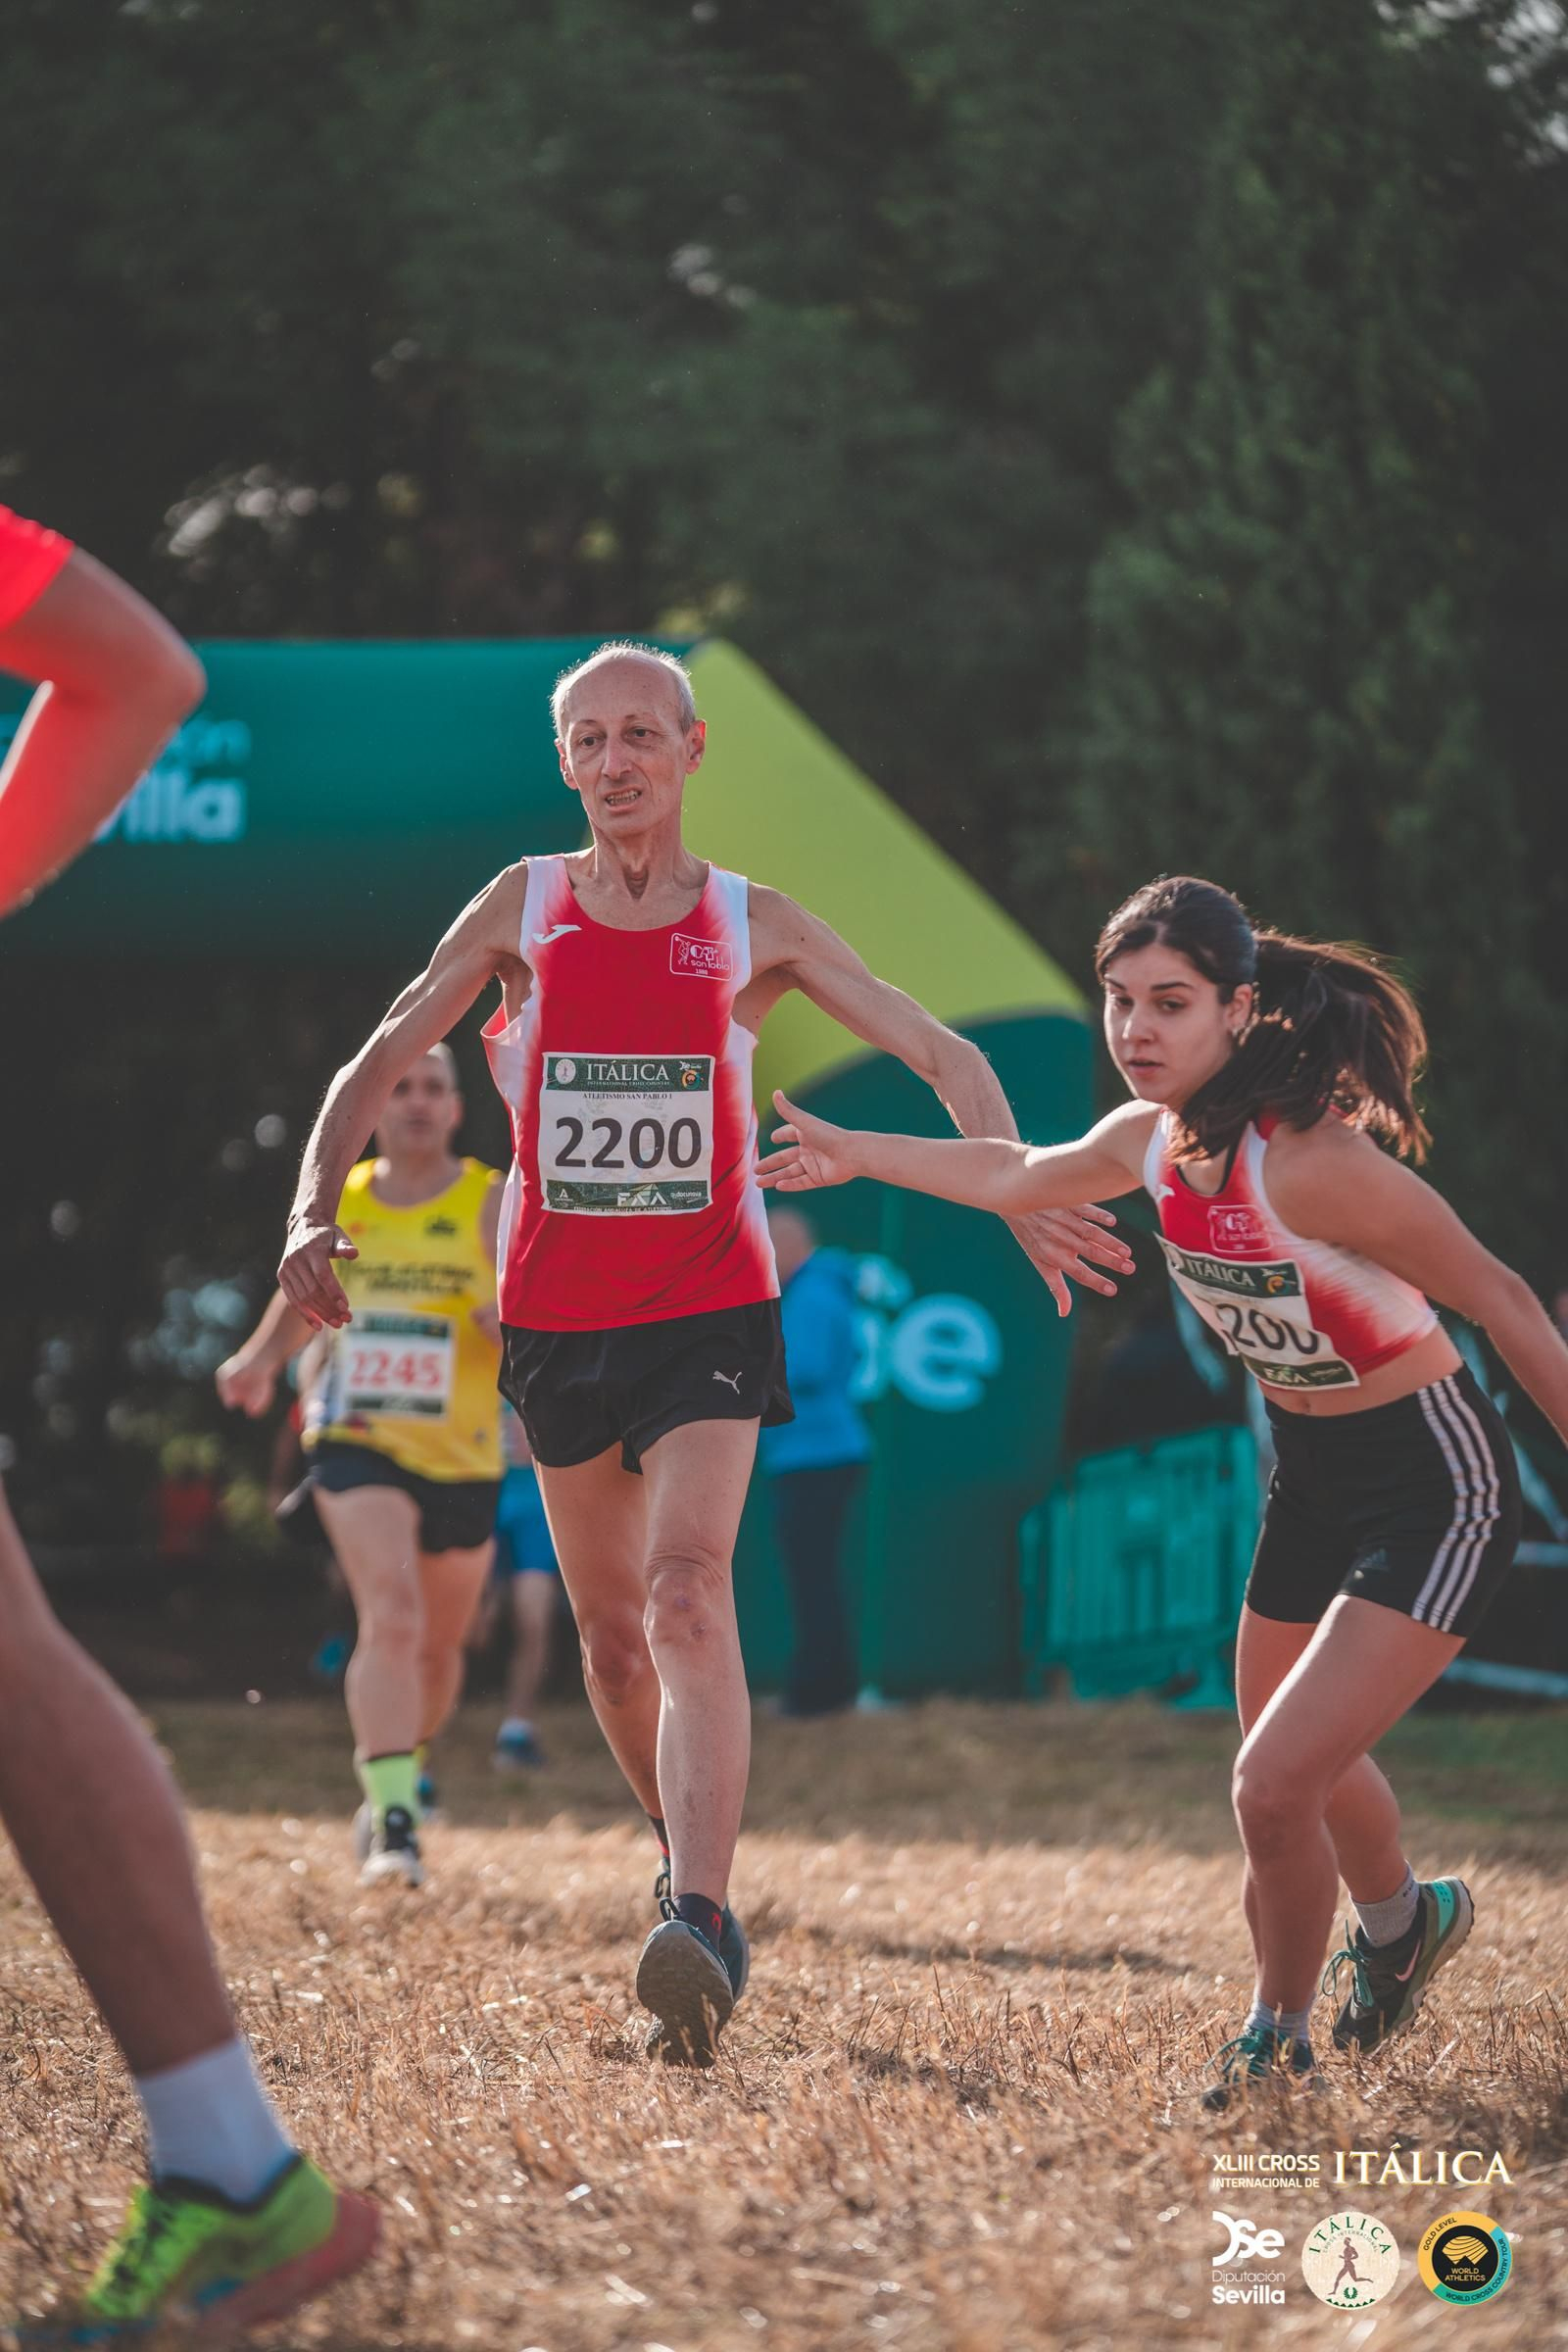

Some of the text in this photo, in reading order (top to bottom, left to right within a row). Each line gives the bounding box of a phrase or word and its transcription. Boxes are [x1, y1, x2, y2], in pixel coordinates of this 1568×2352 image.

[587, 1059, 670, 1082] ITÁLICA
[555, 1116, 702, 1169] 2200
[349, 1347, 442, 1391] 2245
